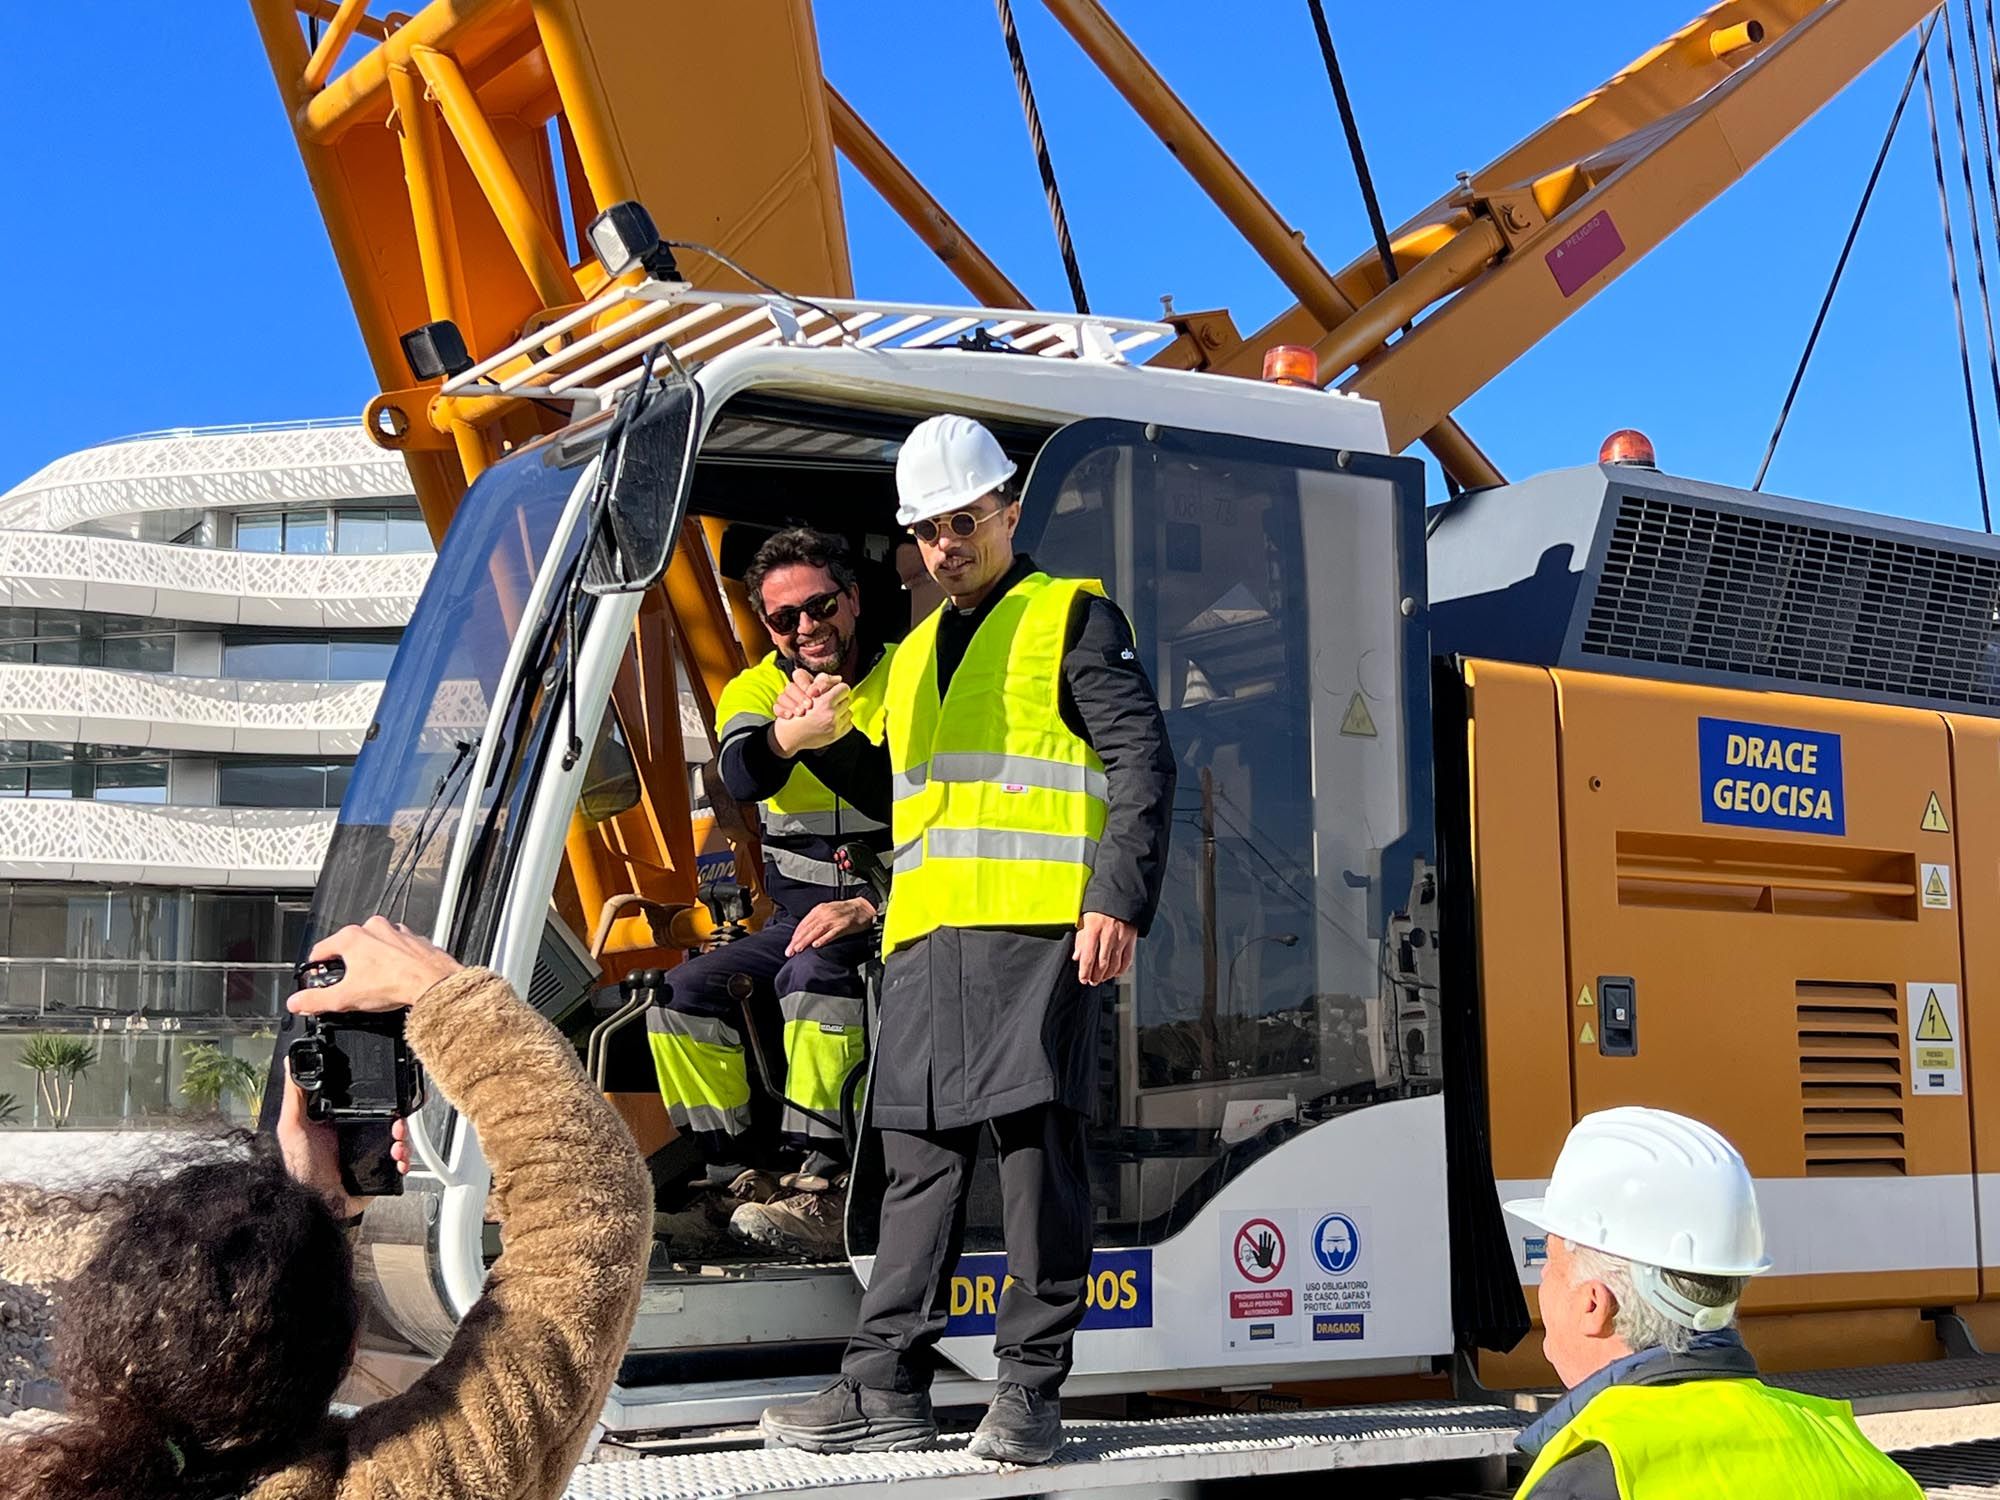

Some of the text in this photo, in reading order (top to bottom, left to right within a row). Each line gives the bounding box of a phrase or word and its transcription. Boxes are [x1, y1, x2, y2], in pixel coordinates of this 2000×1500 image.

[1566, 218, 1601, 248] PELIGRO
[1726, 734, 1818, 774] DRACE
[1713, 778, 1833, 821] GEOCISA
[1305, 1281, 1368, 1291] USO OBLIGATORIO
[1303, 1293, 1313, 1302] DE
[1342, 1291, 1364, 1300] GAFAS
[1365, 1290, 1371, 1299] Y
[1335, 1300, 1371, 1310] AUDITIVOS
[1316, 1322, 1361, 1334] DRAGADOS
